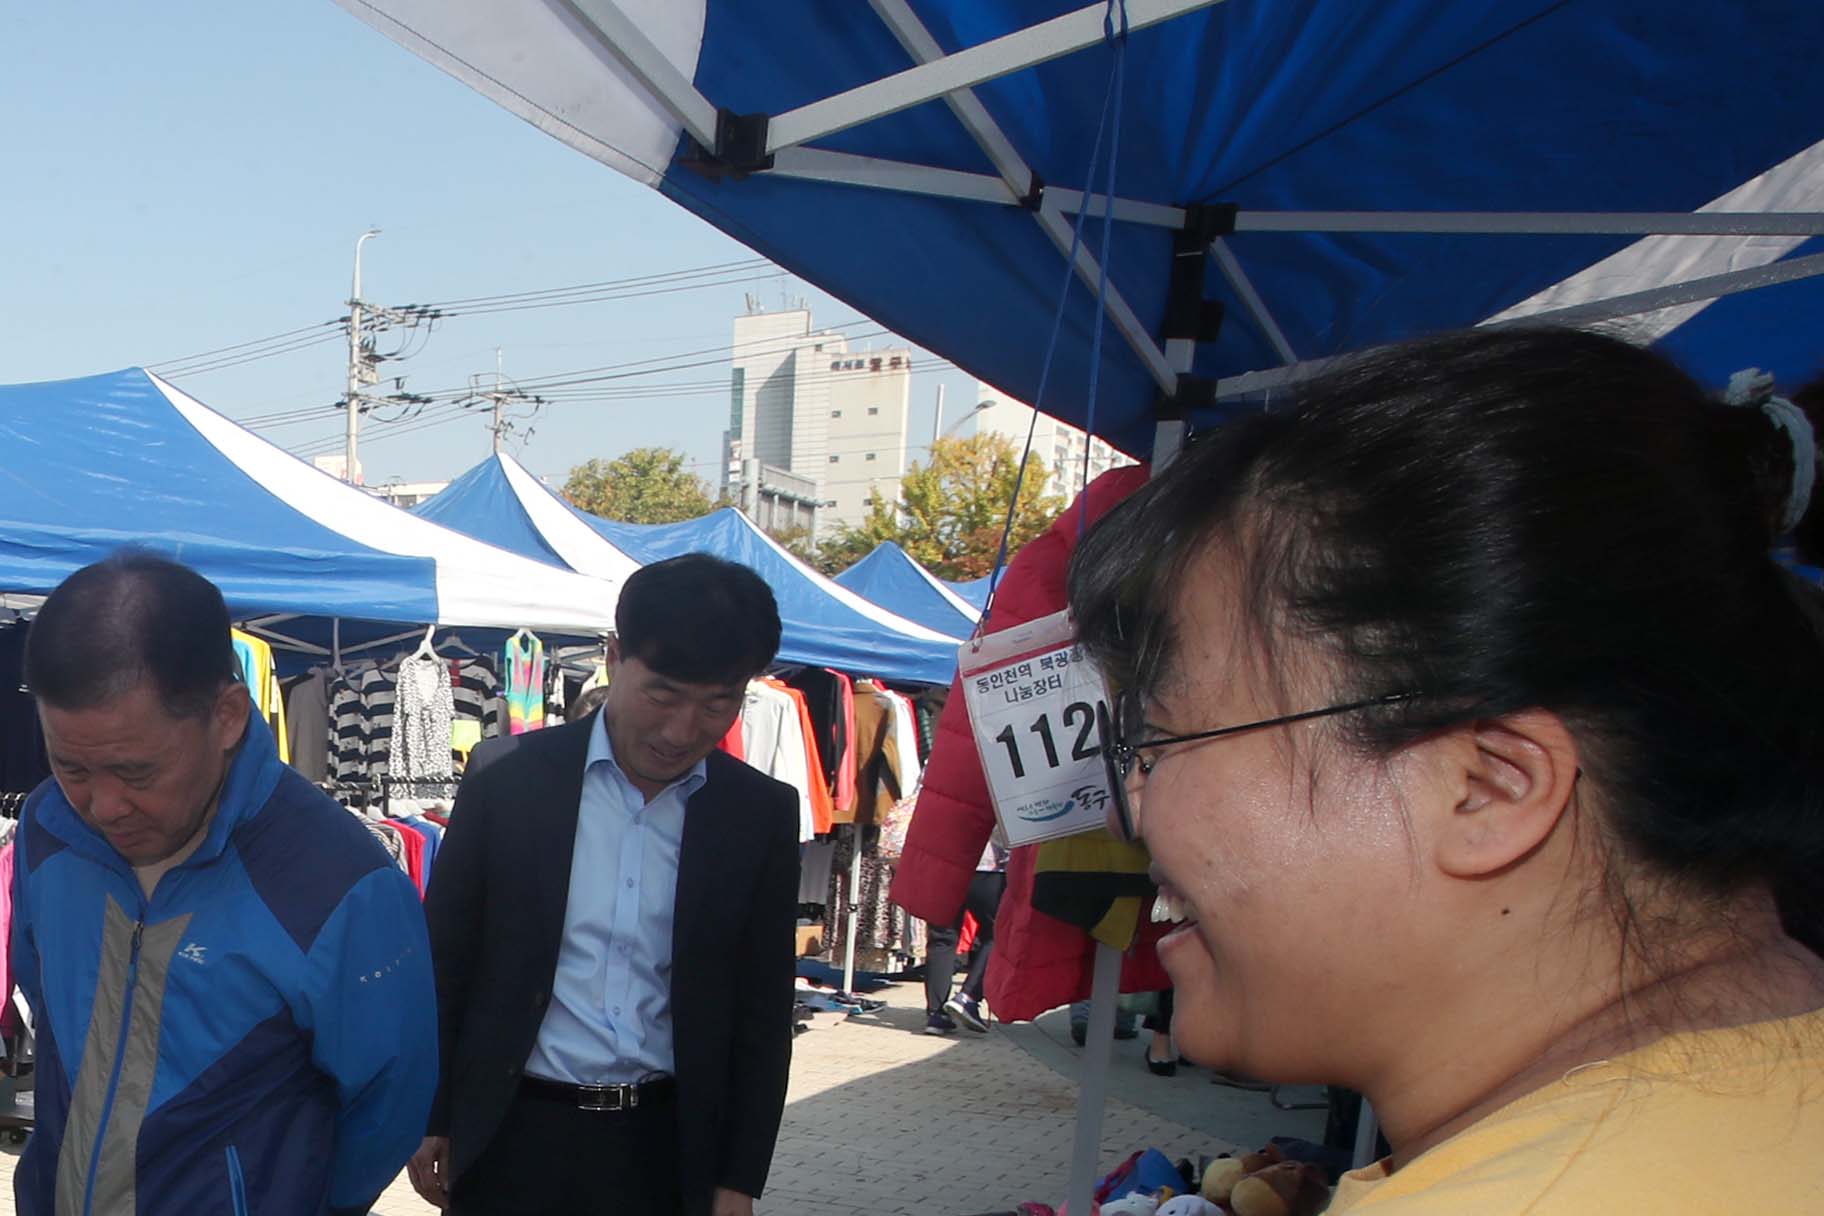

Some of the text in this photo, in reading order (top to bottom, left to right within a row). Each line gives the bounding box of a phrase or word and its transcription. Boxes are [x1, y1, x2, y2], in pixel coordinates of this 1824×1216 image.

[976, 663, 1033, 695] 동인천역
[1004, 674, 1063, 704] 나눔장터
[996, 701, 1102, 779] 112
